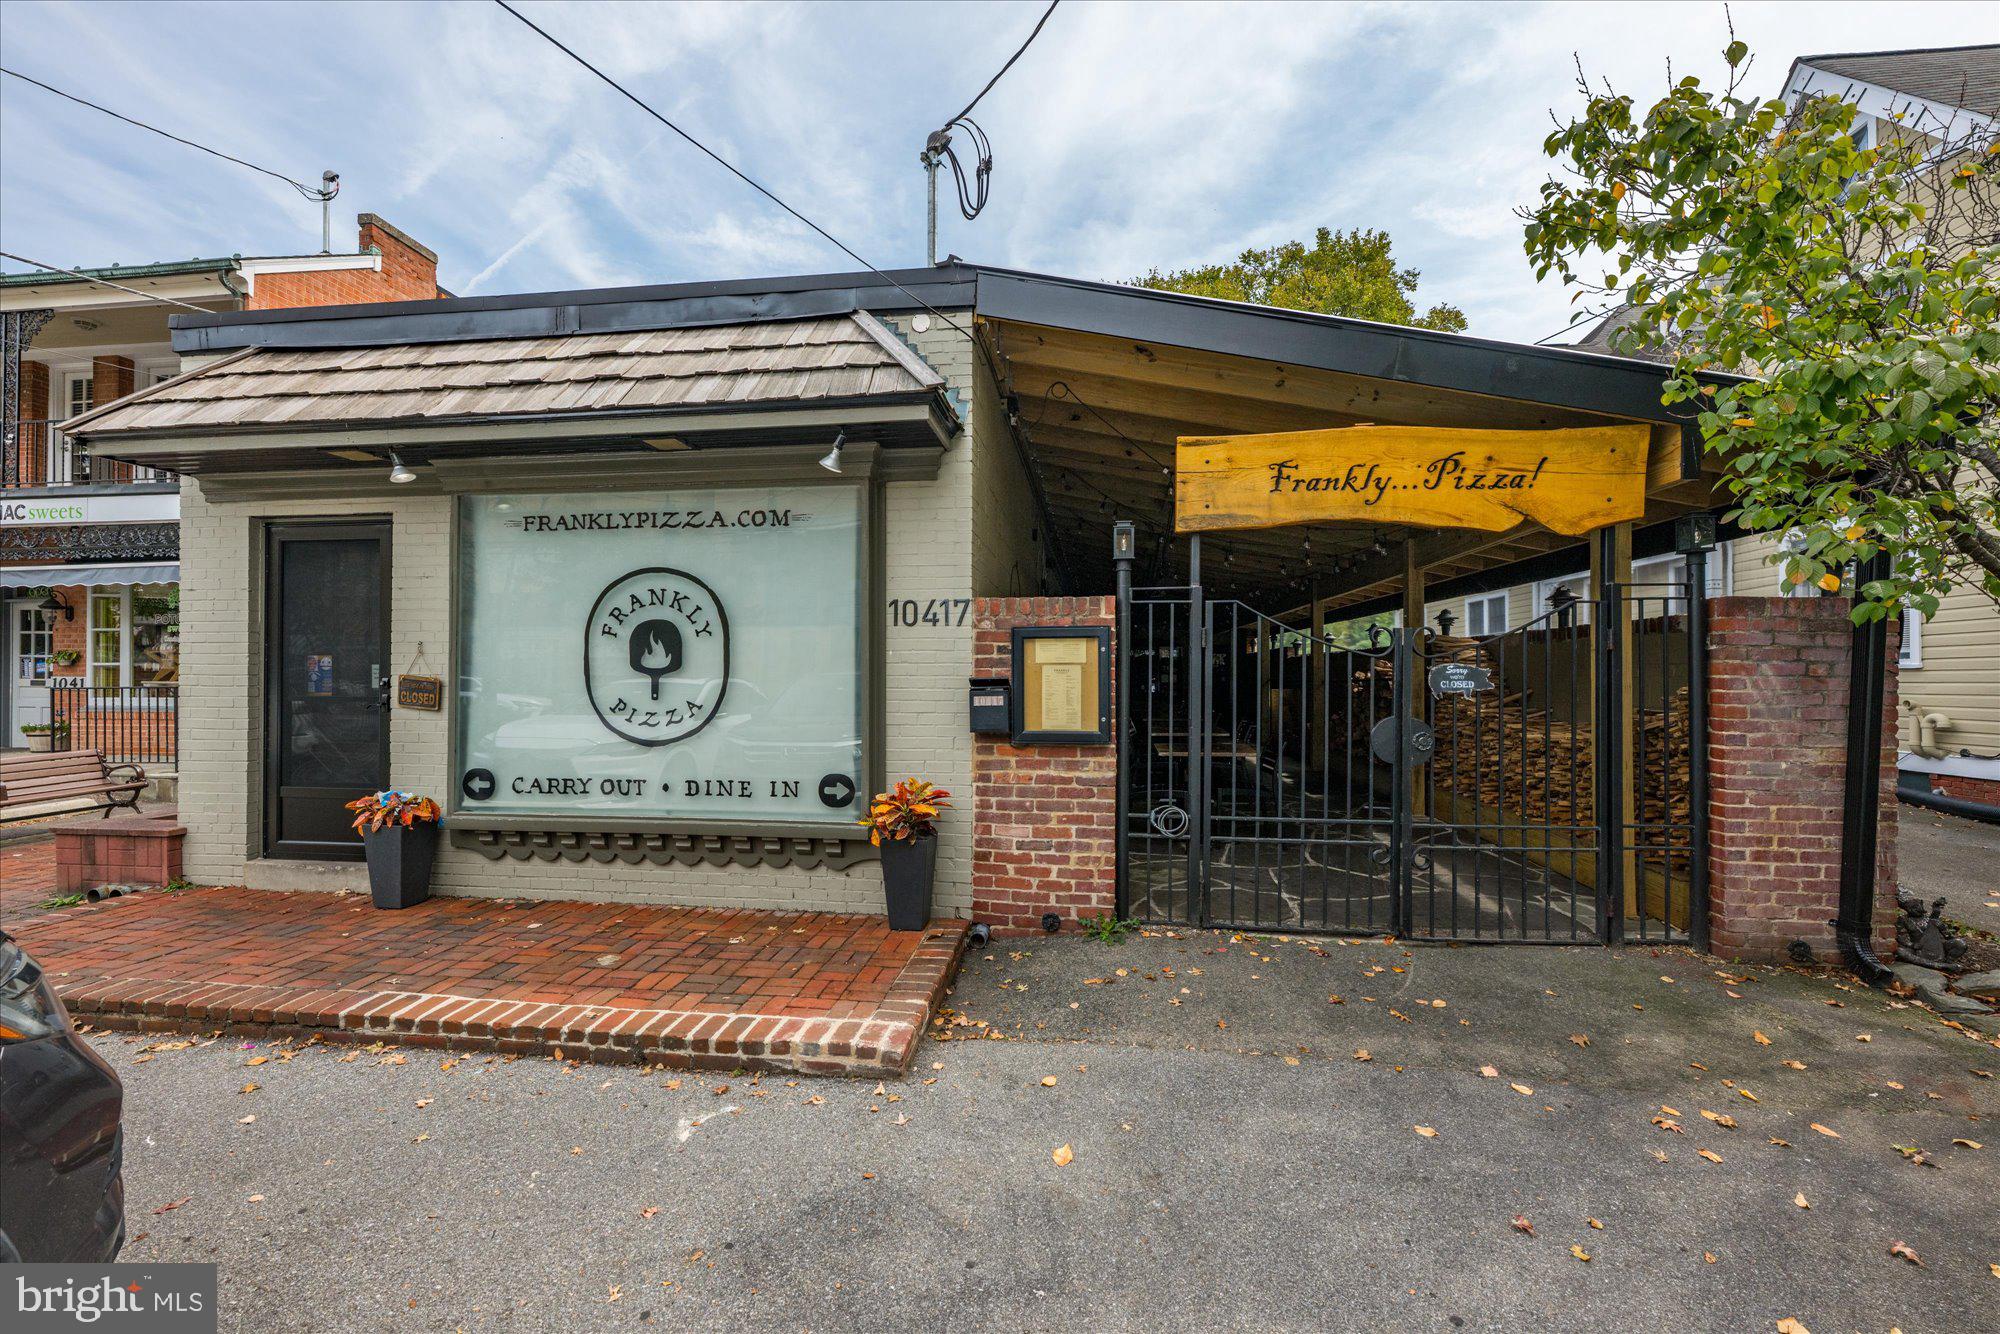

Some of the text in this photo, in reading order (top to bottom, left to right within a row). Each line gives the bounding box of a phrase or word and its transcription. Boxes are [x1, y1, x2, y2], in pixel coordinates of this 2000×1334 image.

[0, 504, 83, 520] AC sweets
[523, 509, 791, 532] FRANKLYPIZZA.COM
[602, 588, 712, 638] FRANKLY
[888, 598, 971, 627] 10417
[1445, 665, 1468, 675] Sorry
[1440, 680, 1475, 688] CLOSED
[400, 690, 435, 705] CLOSED
[609, 697, 703, 728] PIZZA
[511, 777, 801, 798] CARRY OUT DINE IN
